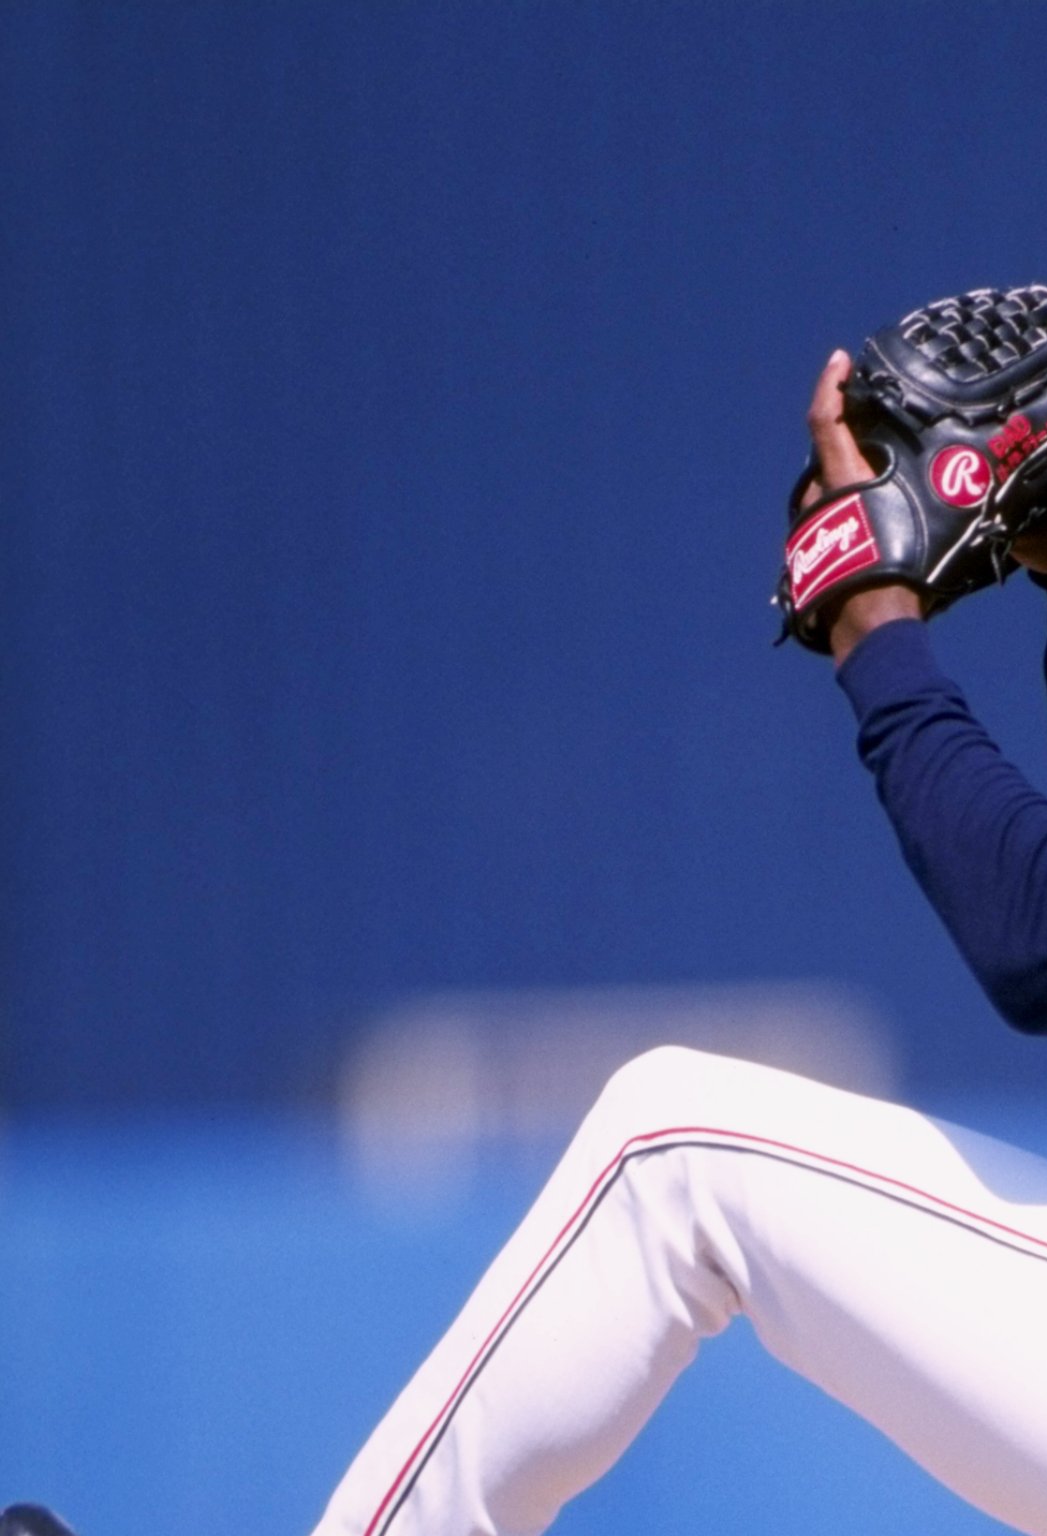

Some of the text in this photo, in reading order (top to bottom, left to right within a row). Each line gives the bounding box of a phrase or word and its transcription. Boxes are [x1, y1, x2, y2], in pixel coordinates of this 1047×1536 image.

[987, 412, 1032, 459] DAD
[941, 450, 982, 497] R
[793, 516, 859, 584] Rawlings
